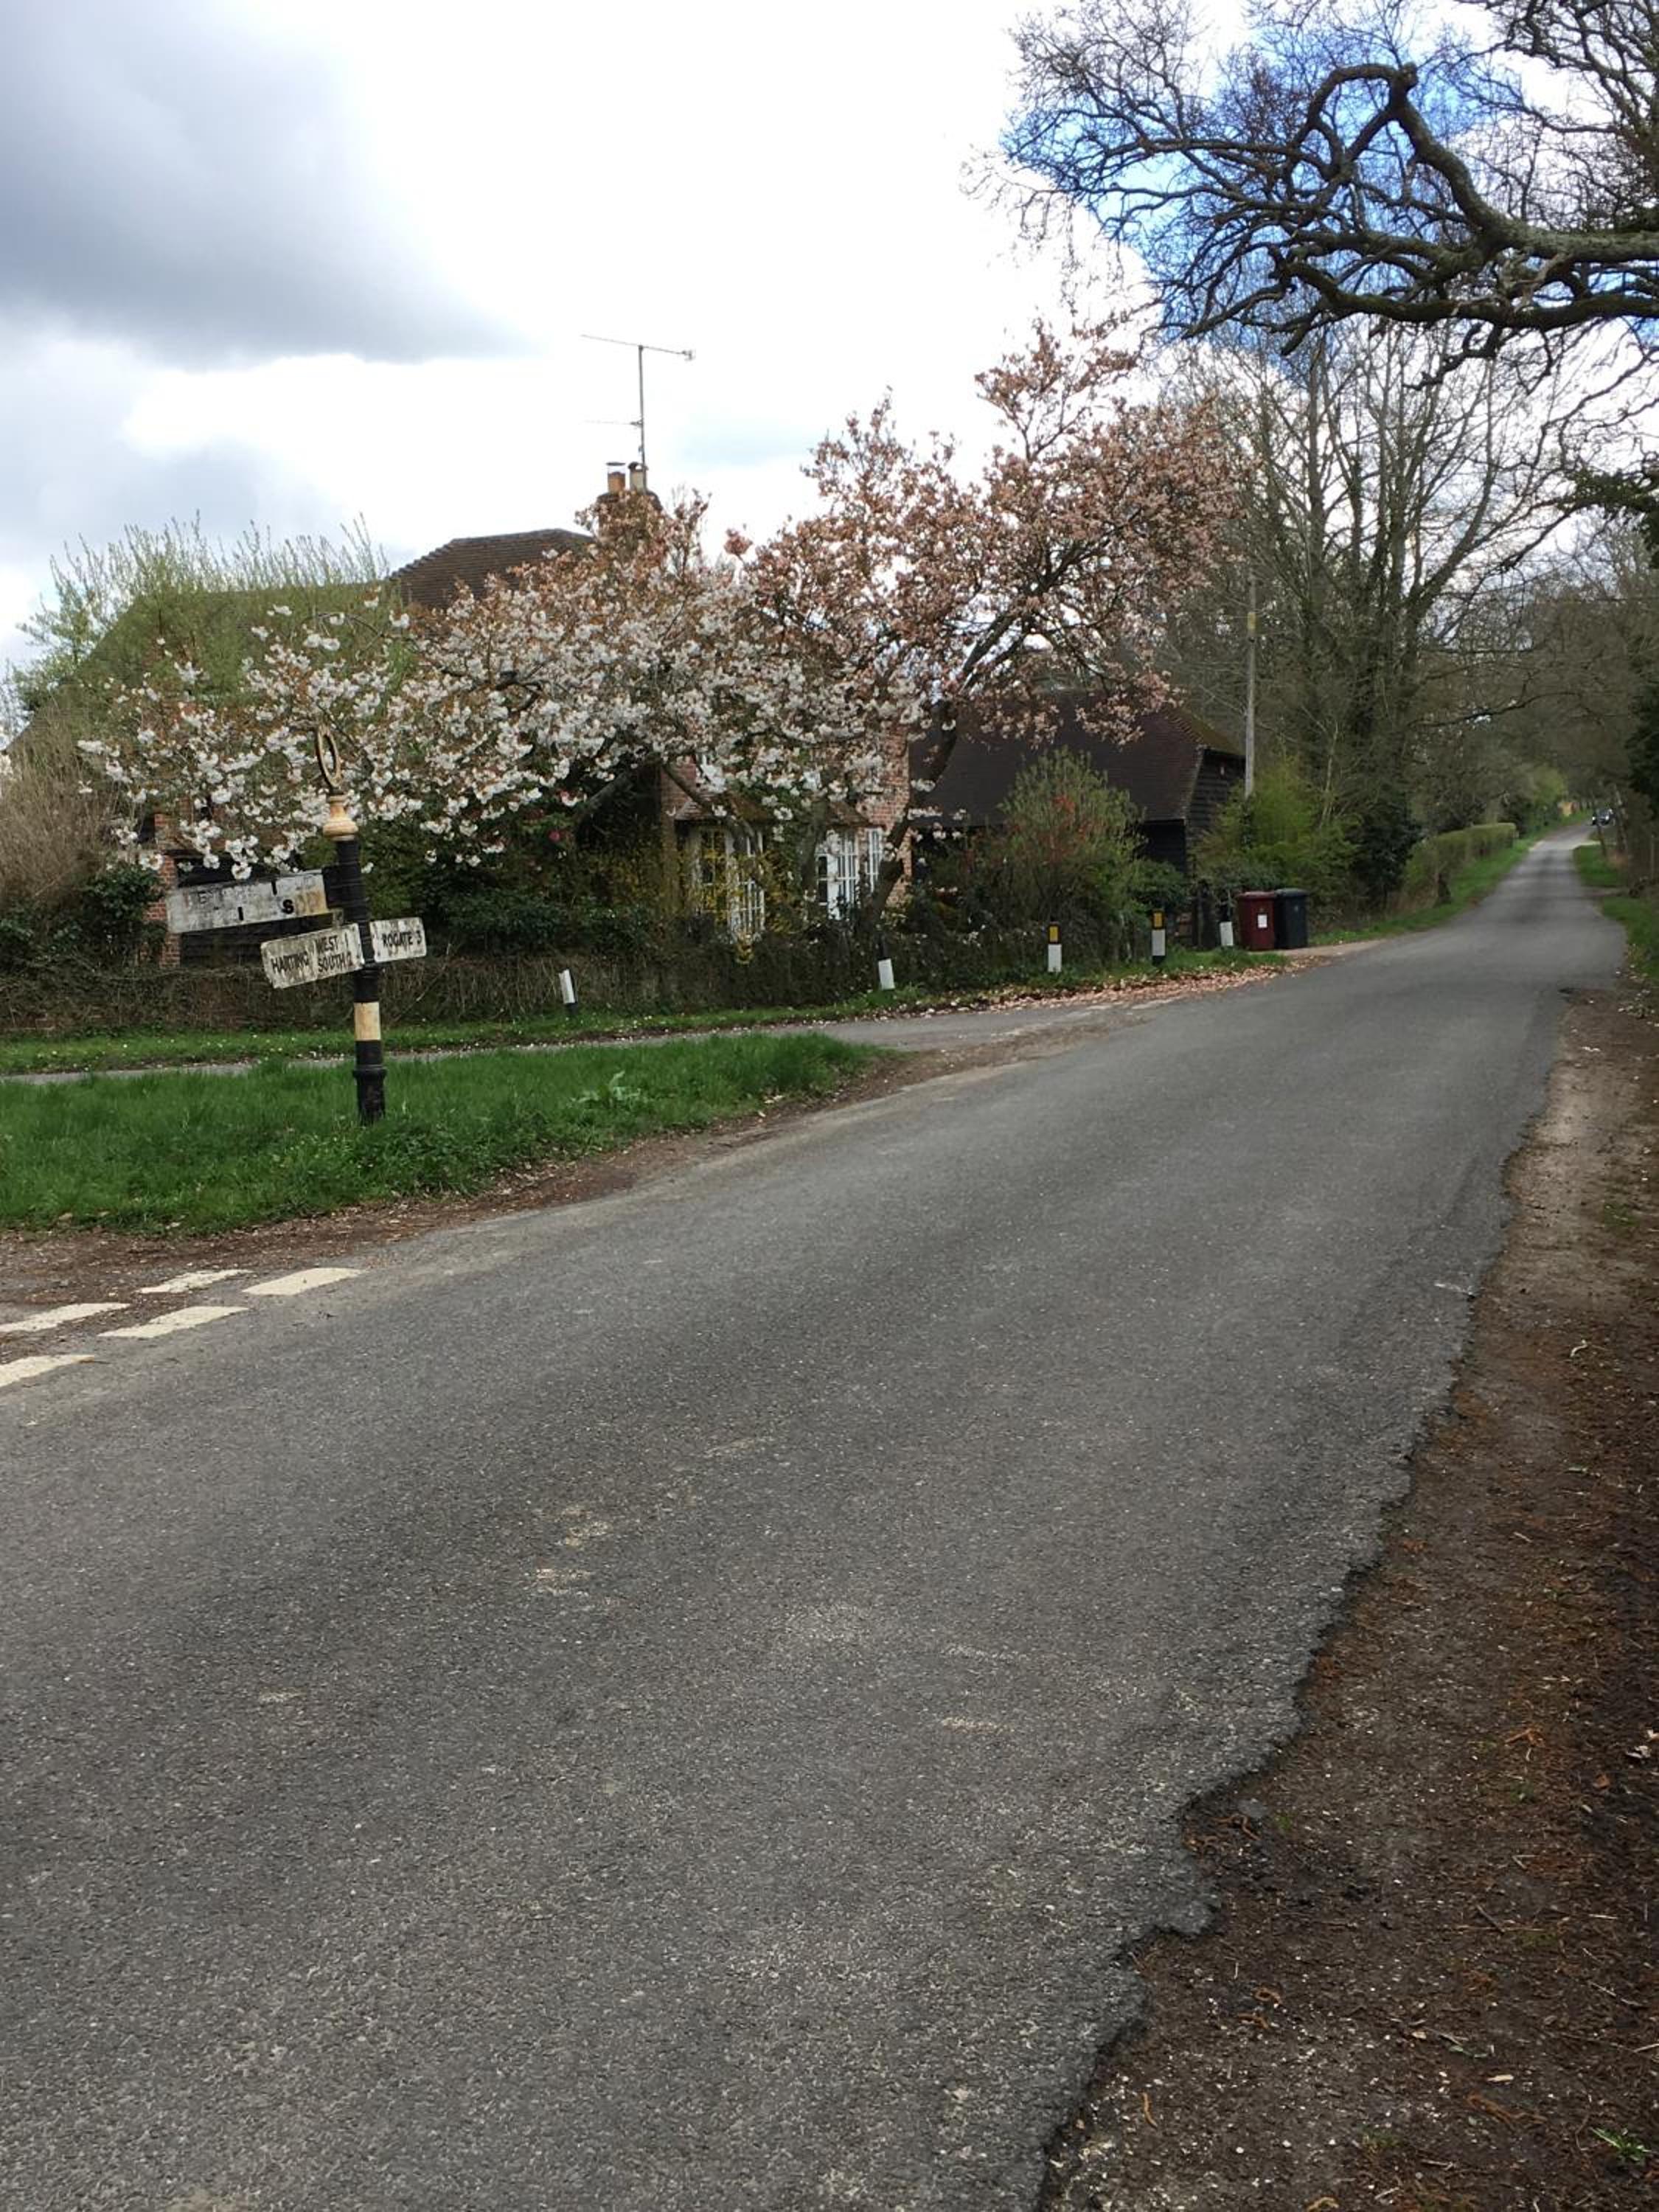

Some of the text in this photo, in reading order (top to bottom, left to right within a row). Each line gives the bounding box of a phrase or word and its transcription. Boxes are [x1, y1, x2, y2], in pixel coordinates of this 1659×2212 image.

[316, 935, 338, 953] WEST
[382, 930, 422, 947] ROGATE 3
[271, 951, 309, 973] HARTING
[318, 952, 345, 973] SOUTH
